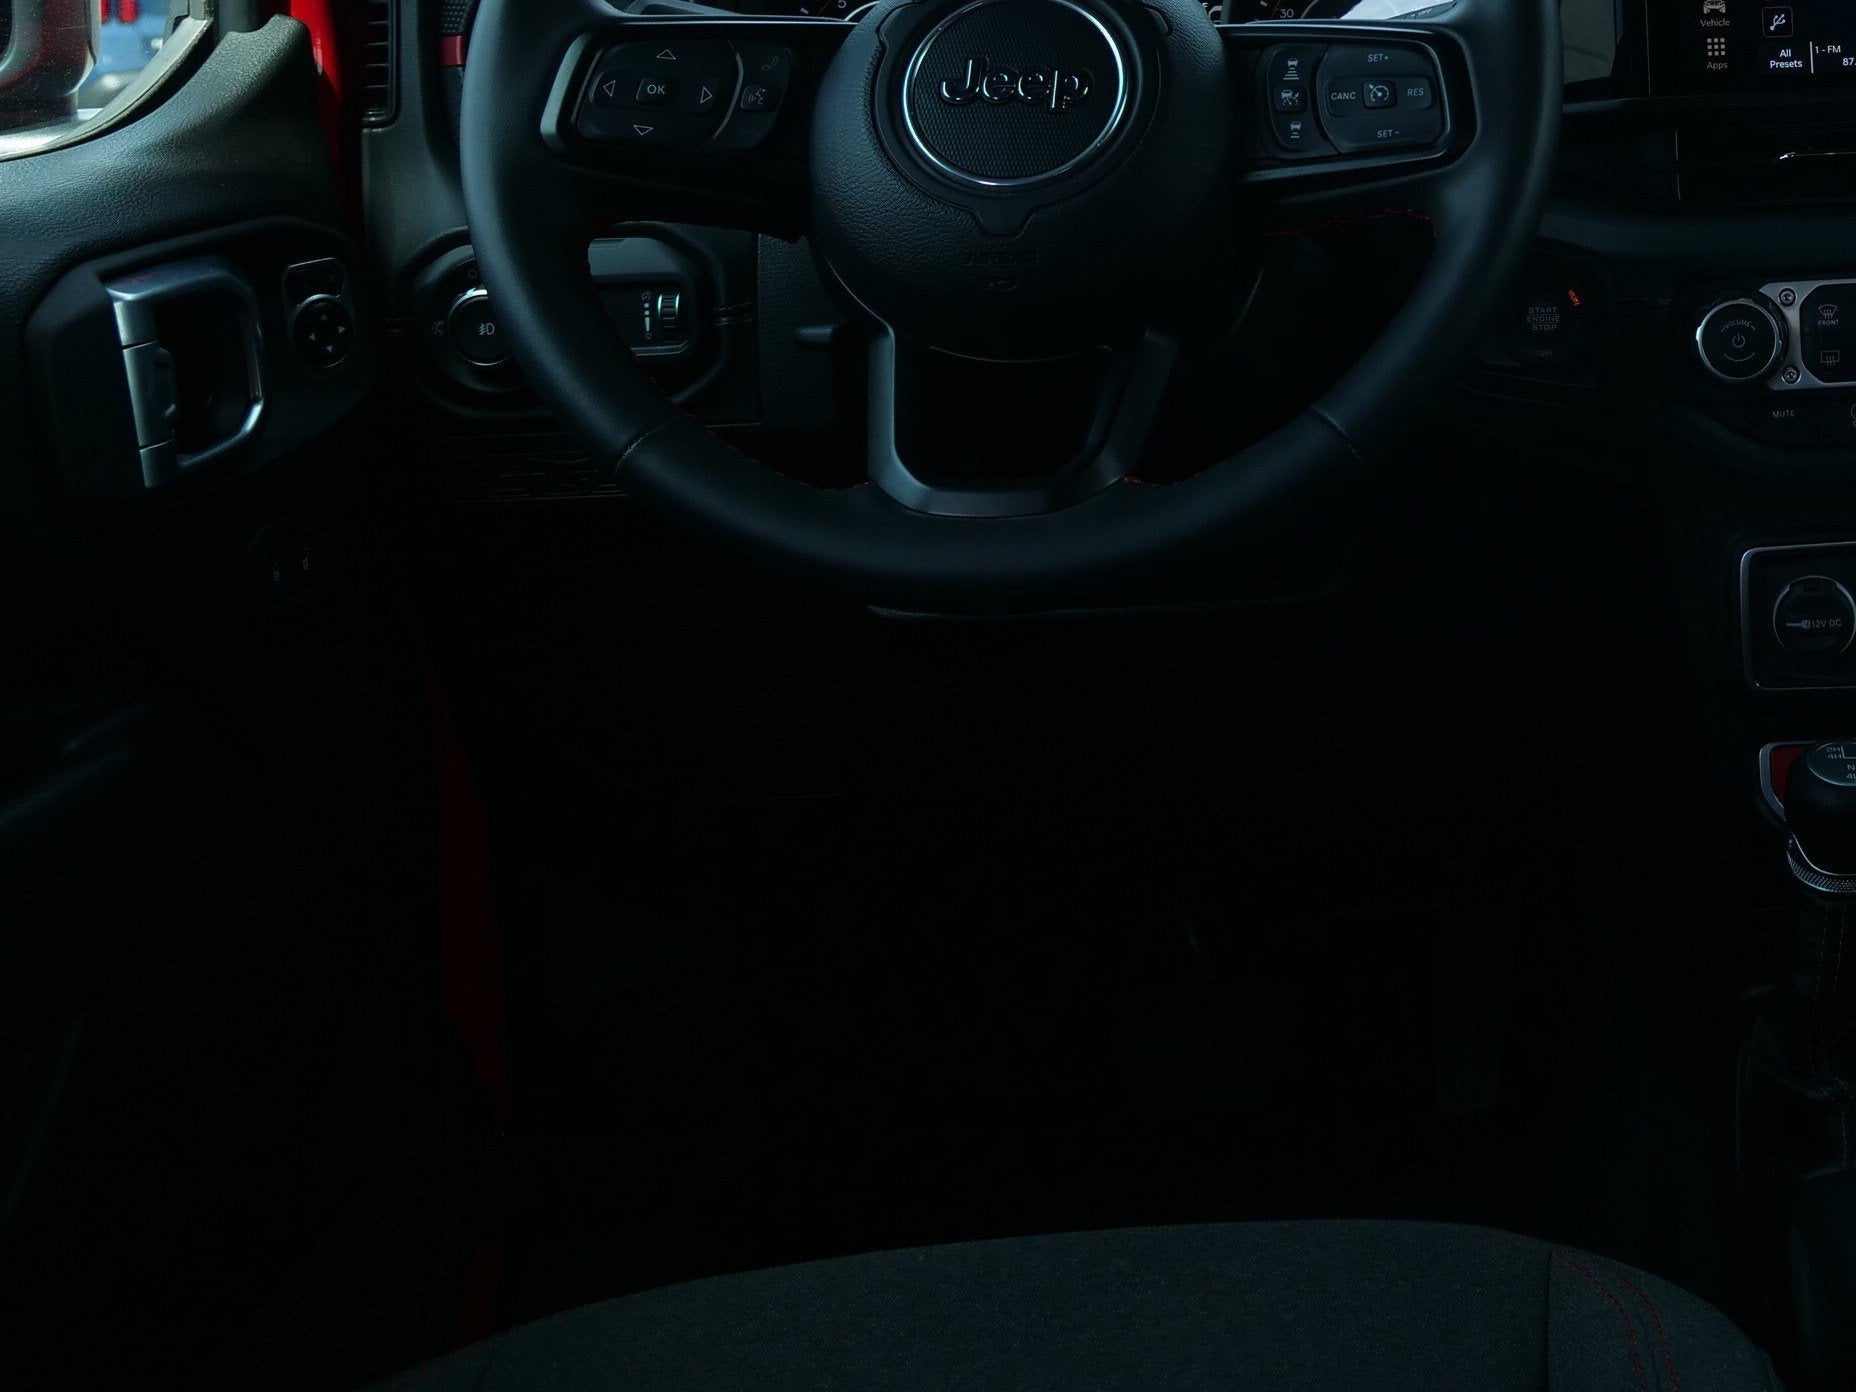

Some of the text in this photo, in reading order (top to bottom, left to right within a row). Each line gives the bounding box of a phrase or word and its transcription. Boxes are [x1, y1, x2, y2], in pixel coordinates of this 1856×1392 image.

[1279, 8, 1295, 19] 30
[1699, 18, 1731, 27] Vehicle
[1368, 53, 1389, 63] SET+
[1778, 48, 1792, 58] All
[1706, 61, 1729, 71] Apps
[1770, 59, 1803, 69] Presets
[940, 55, 1095, 111] Jeep
[646, 84, 667, 95] OK
[1407, 88, 1424, 97] RES
[1331, 91, 1356, 101] CANC
[1528, 306, 1558, 314] START
[1818, 318, 1840, 327] FRONT
[1772, 409, 1795, 418] MUTE
[1847, 764, 1856, 772] N
